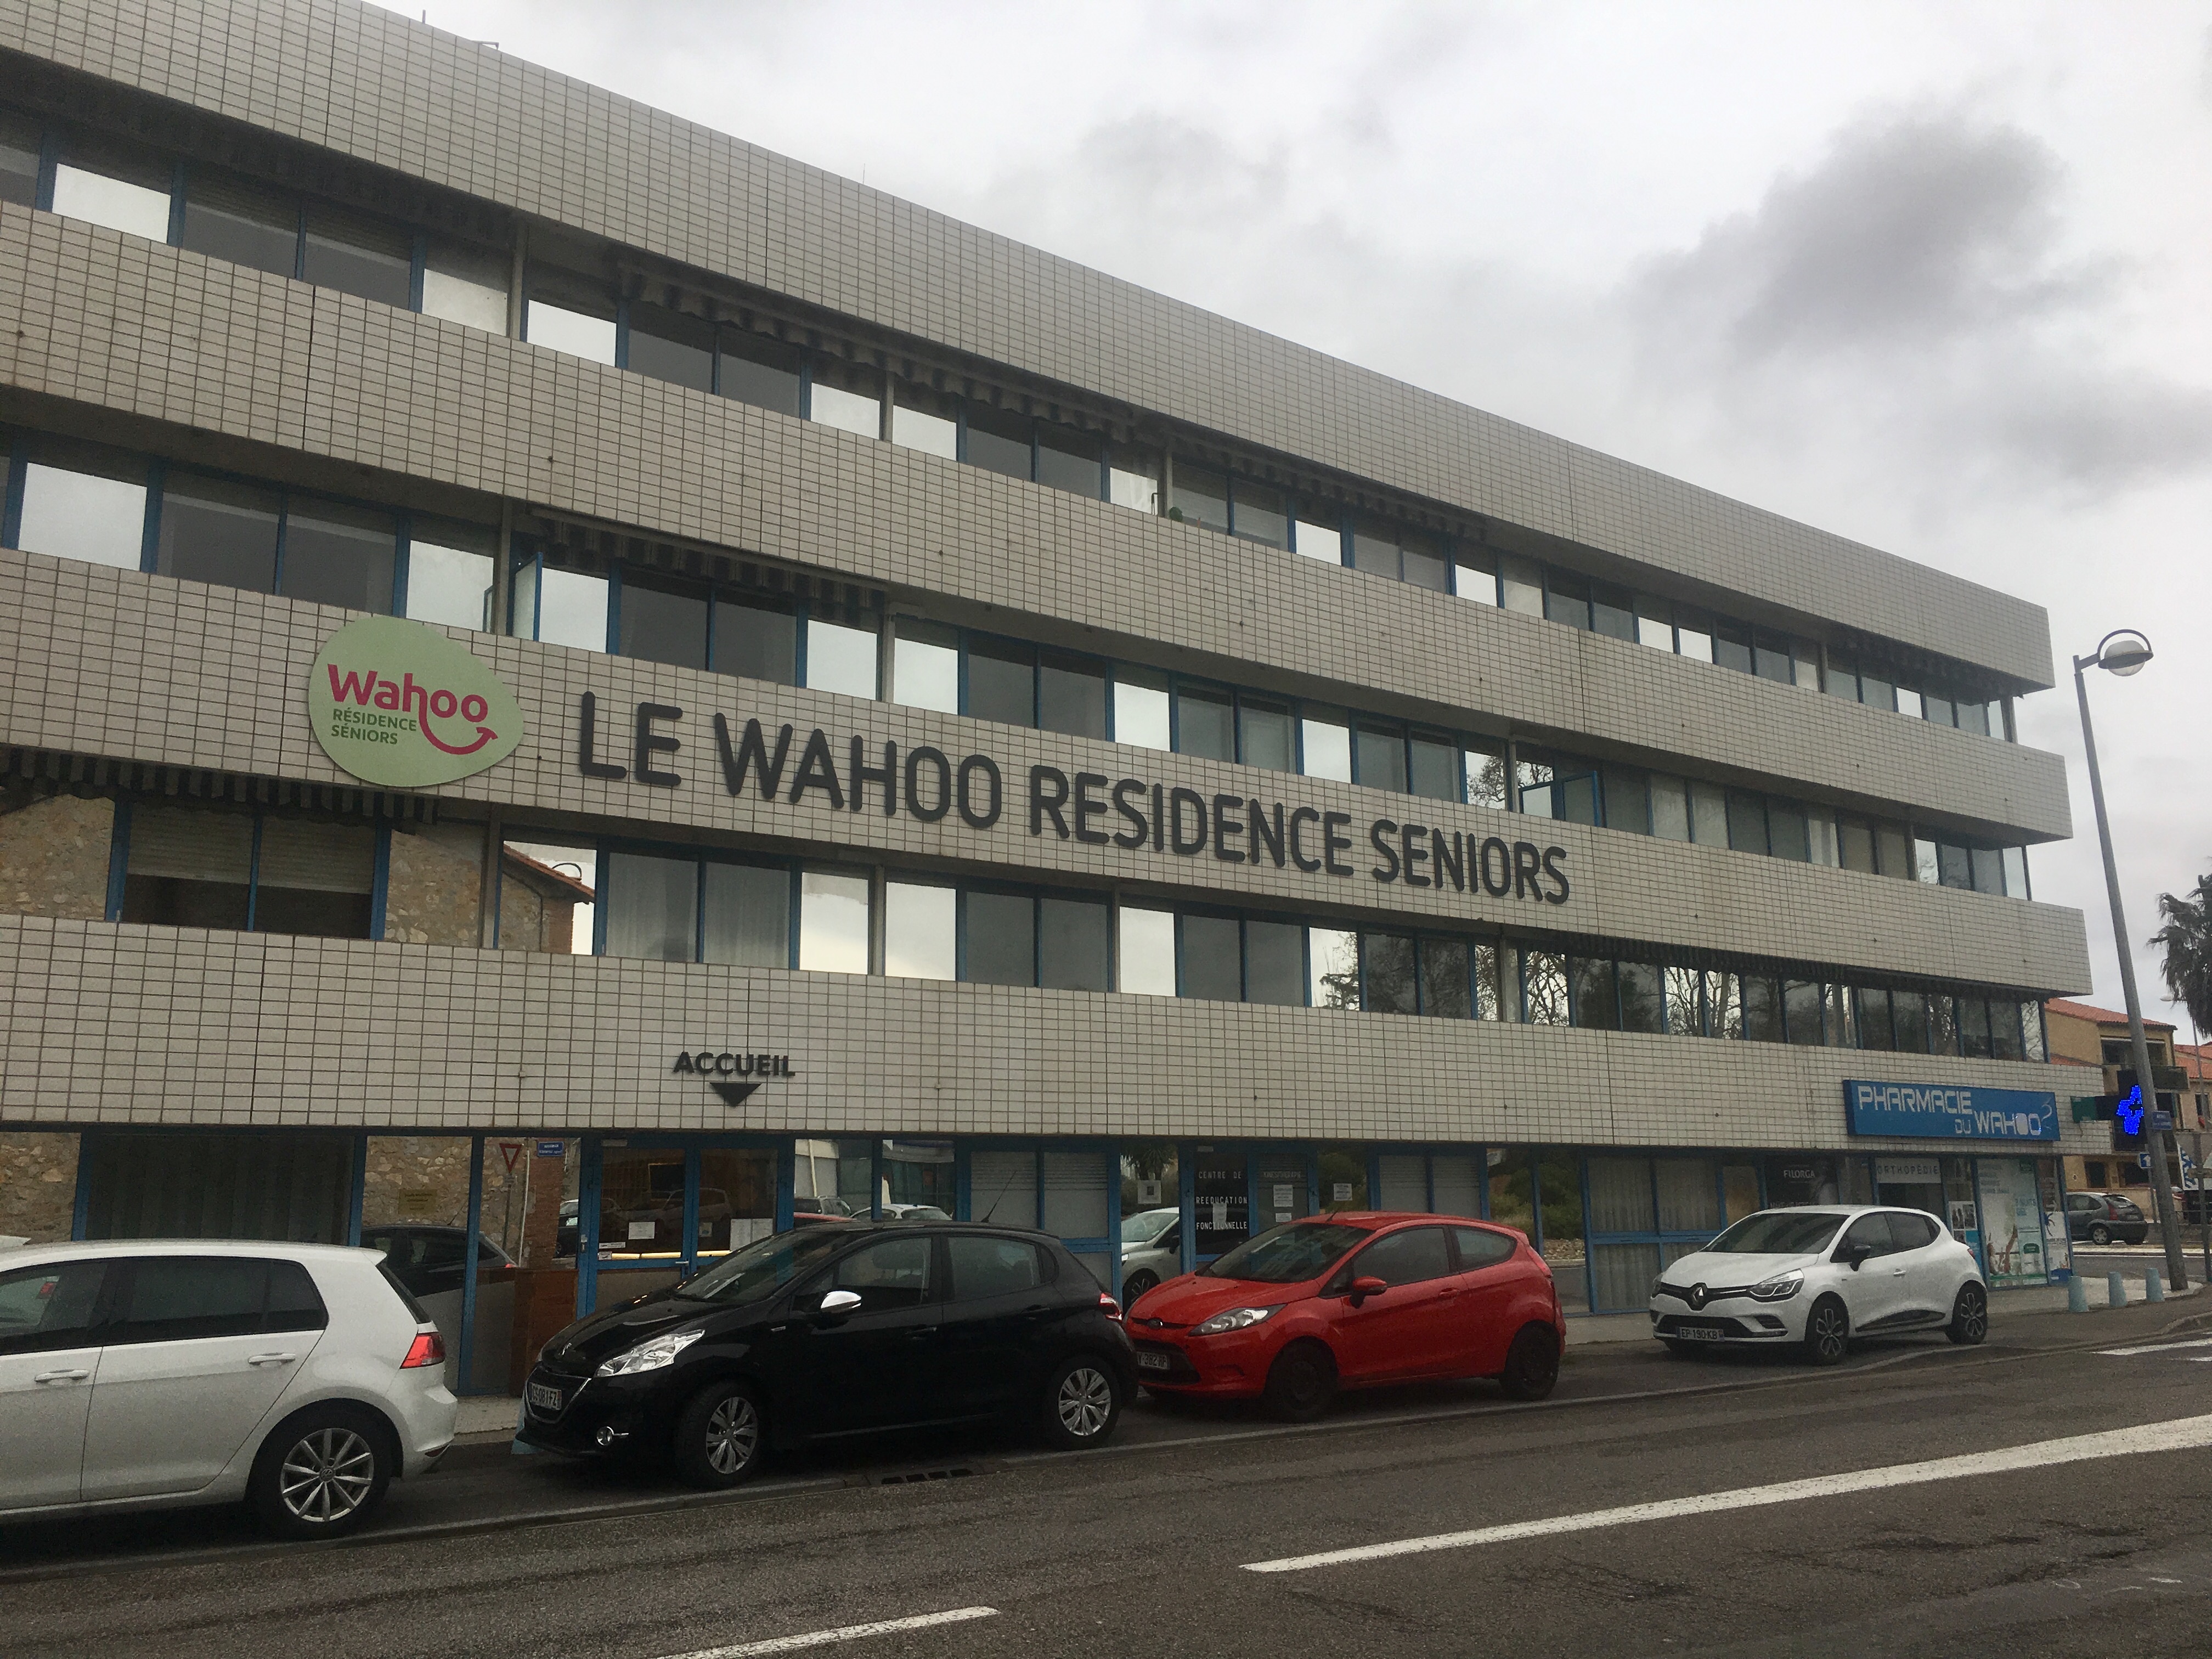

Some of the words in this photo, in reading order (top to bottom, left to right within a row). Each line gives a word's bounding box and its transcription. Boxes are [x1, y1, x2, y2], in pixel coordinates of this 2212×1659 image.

[328, 664, 490, 727] Wahoo
[333, 708, 417, 731] RÉSIDENCE
[331, 723, 398, 745] SÉNIORS
[579, 690, 684, 787] LE
[715, 712, 1002, 828] WAHOO
[1030, 764, 1355, 877] RESIDENCE
[1370, 818, 1570, 905] SENIORS
[673, 1051, 795, 1077] ACCUEIL
[1858, 1085, 1973, 1115] PHARMACIE
[1955, 1119, 1971, 1135] DU
[1974, 1110, 2041, 1136] WAHOO
[1784, 1170, 1815, 1178] FILORGA
[1196, 1196, 1248, 1204] REEDUCATION
[1196, 1221, 1248, 1230] FONCTIONNELLE
